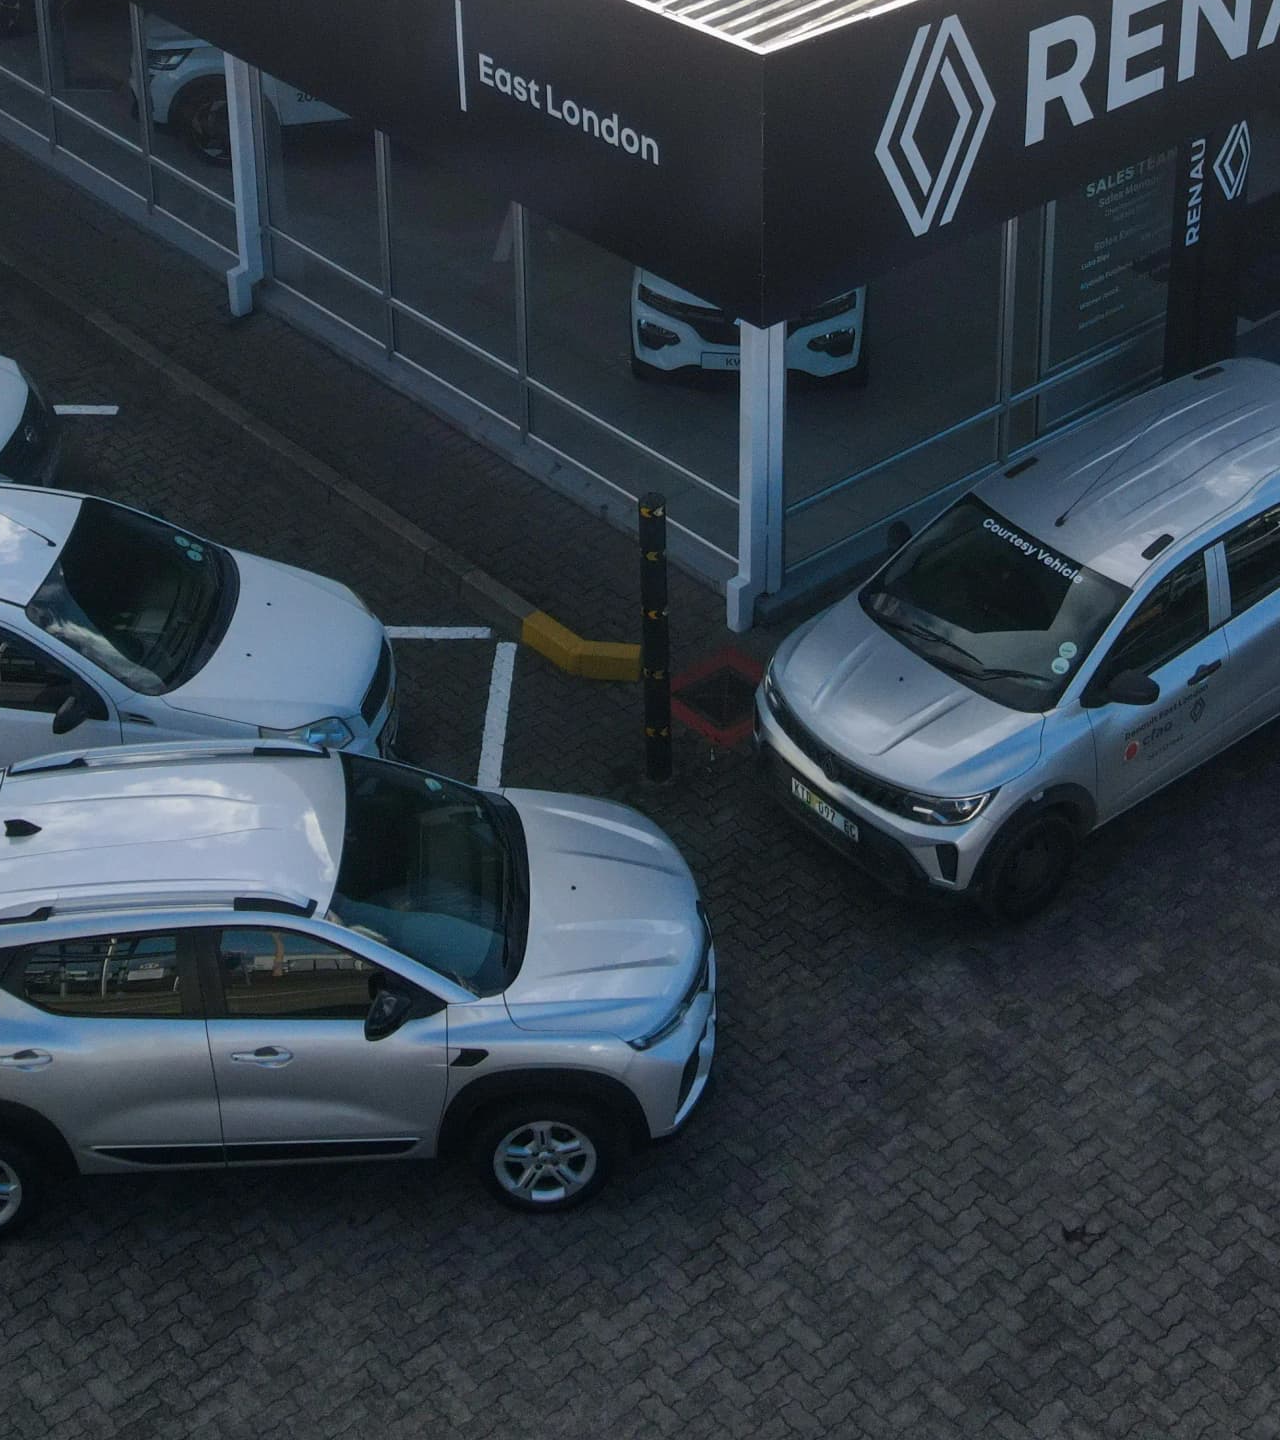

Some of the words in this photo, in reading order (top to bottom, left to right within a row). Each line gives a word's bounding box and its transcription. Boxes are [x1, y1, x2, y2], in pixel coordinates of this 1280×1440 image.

[297, 92, 320, 103] 20
[478, 53, 540, 109] East
[546, 84, 659, 165] London
[1086, 165, 1135, 198] SALES
[983, 518, 1037, 556] Courtesy
[1037, 549, 1083, 584] Vehicle
